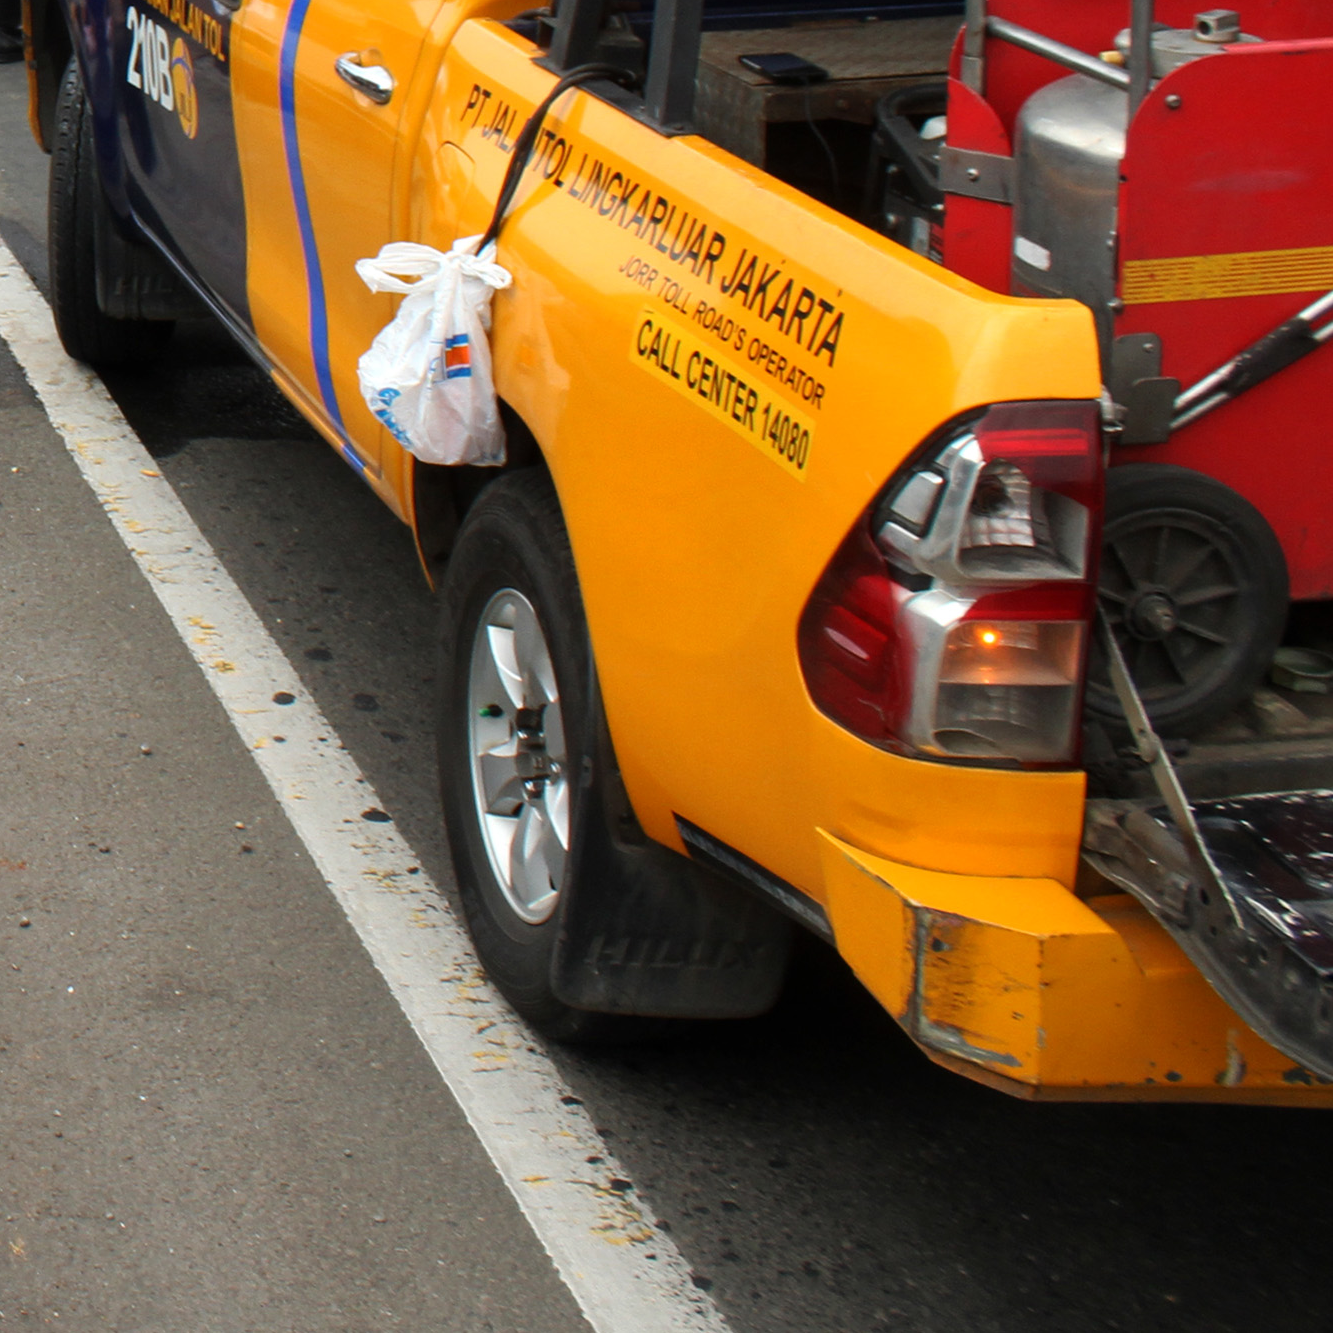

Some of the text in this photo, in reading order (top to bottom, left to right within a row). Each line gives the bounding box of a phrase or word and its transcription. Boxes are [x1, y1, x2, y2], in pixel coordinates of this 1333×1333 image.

[126, 6, 175, 113] 210B
[203, 12, 226, 62] TOL
[460, 83, 492, 129] PT
[532, 129, 574, 188] TOL
[720, 248, 845, 368] JAKARTA
[620, 255, 826, 411] JORR TOLL ROAD'S OPERATOR
[636, 319, 810, 471] CALL CENTER 14080
